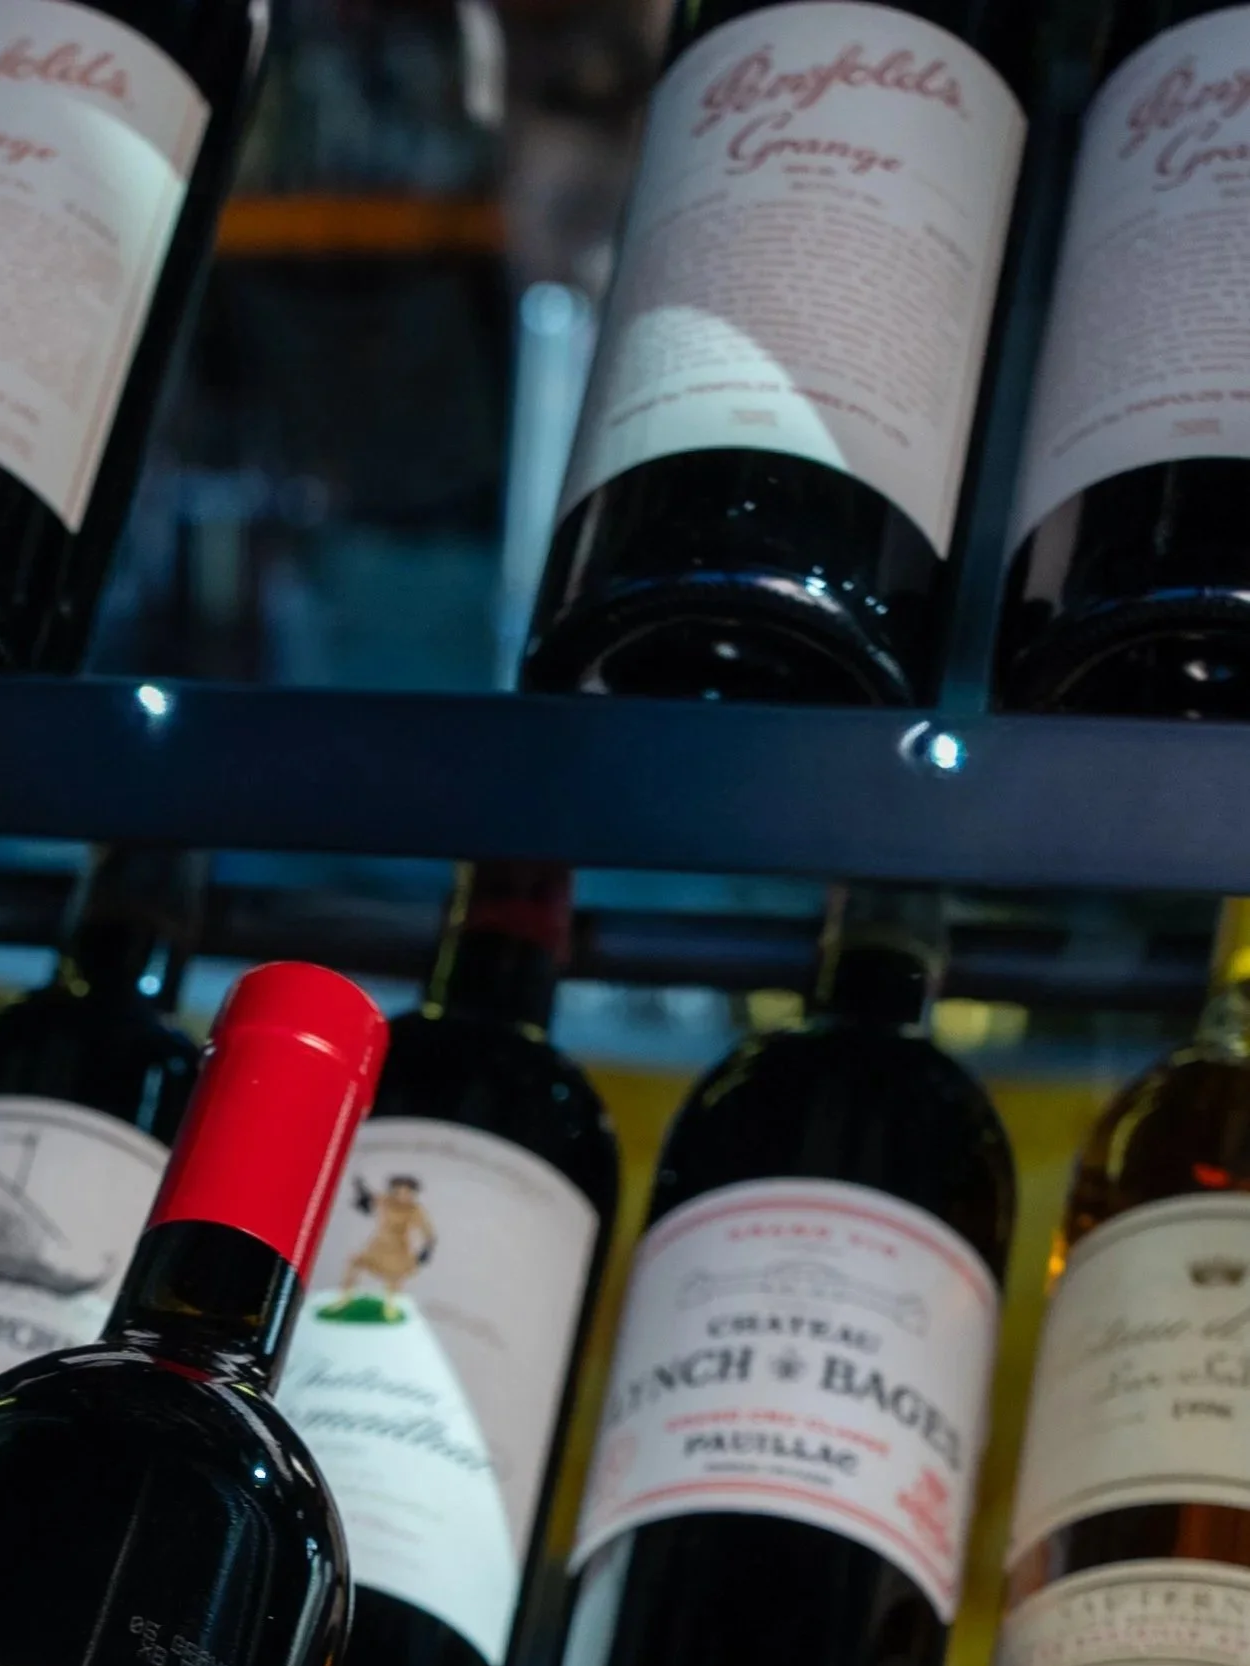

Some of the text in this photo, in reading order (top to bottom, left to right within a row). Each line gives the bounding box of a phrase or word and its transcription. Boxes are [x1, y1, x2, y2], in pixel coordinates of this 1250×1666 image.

[691, 42, 968, 138] Penfolds
[726, 111, 904, 176] Grange
[683, 1431, 860, 1477] PAUILLAC
